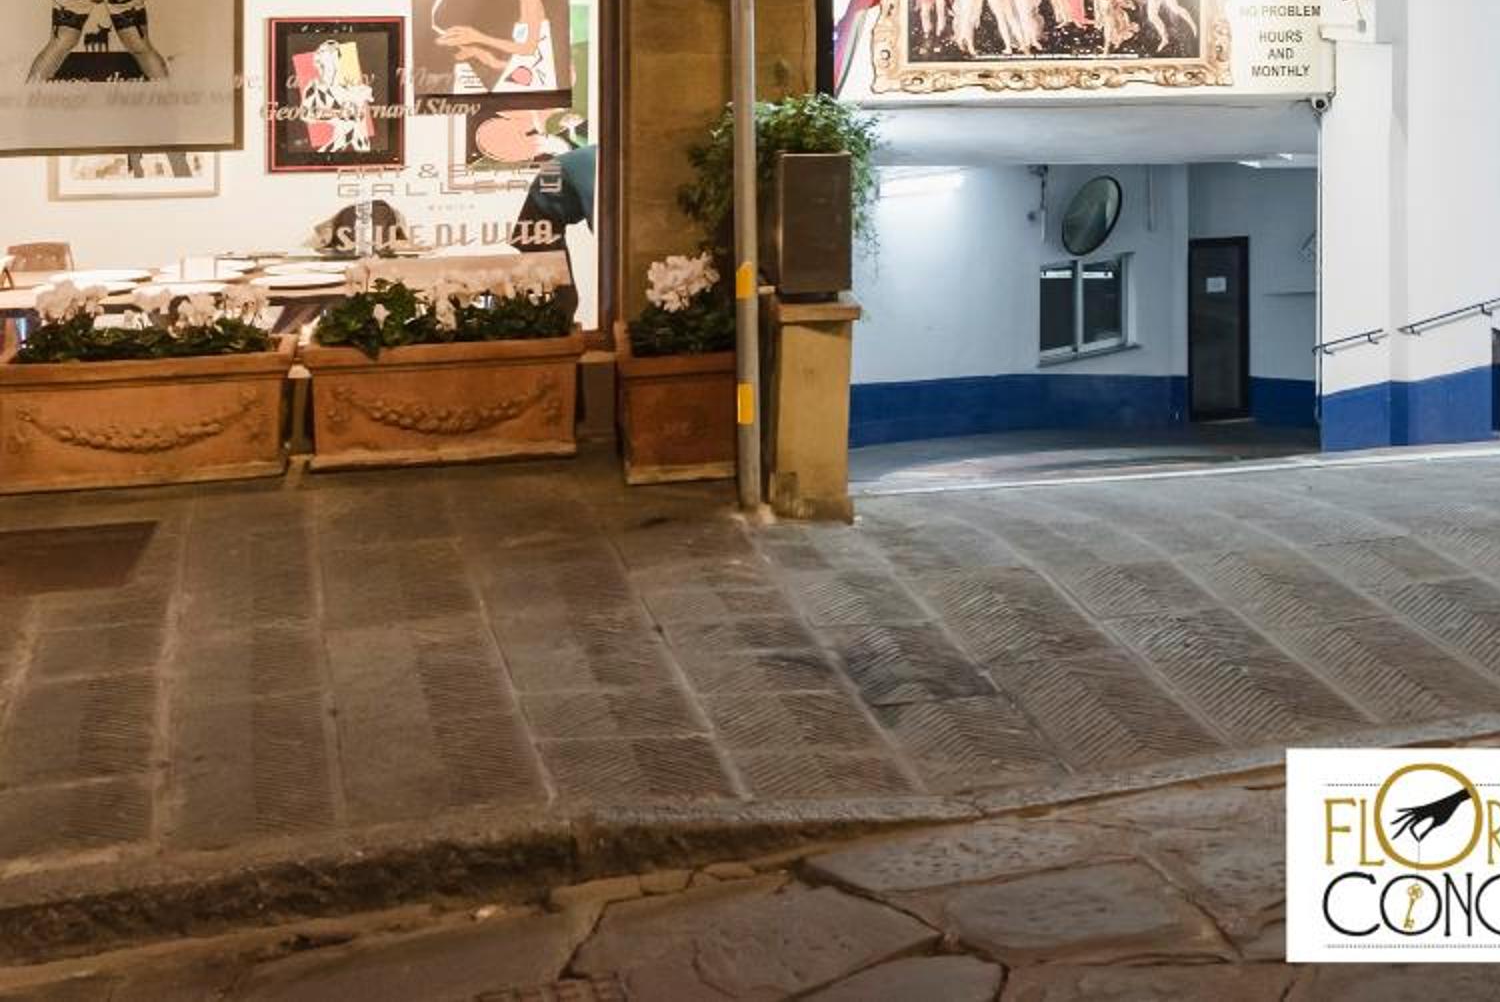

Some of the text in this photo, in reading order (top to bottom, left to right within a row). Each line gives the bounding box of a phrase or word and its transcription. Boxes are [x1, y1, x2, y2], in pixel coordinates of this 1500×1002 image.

[1261, 5, 1321, 17] PROBLEM
[1259, 30, 1303, 43] HOURS
[1267, 47, 1295, 60] AND
[1251, 65, 1310, 78] MONTHLY
[419, 99, 481, 118] Shaw
[337, 178, 562, 197] GALLERY
